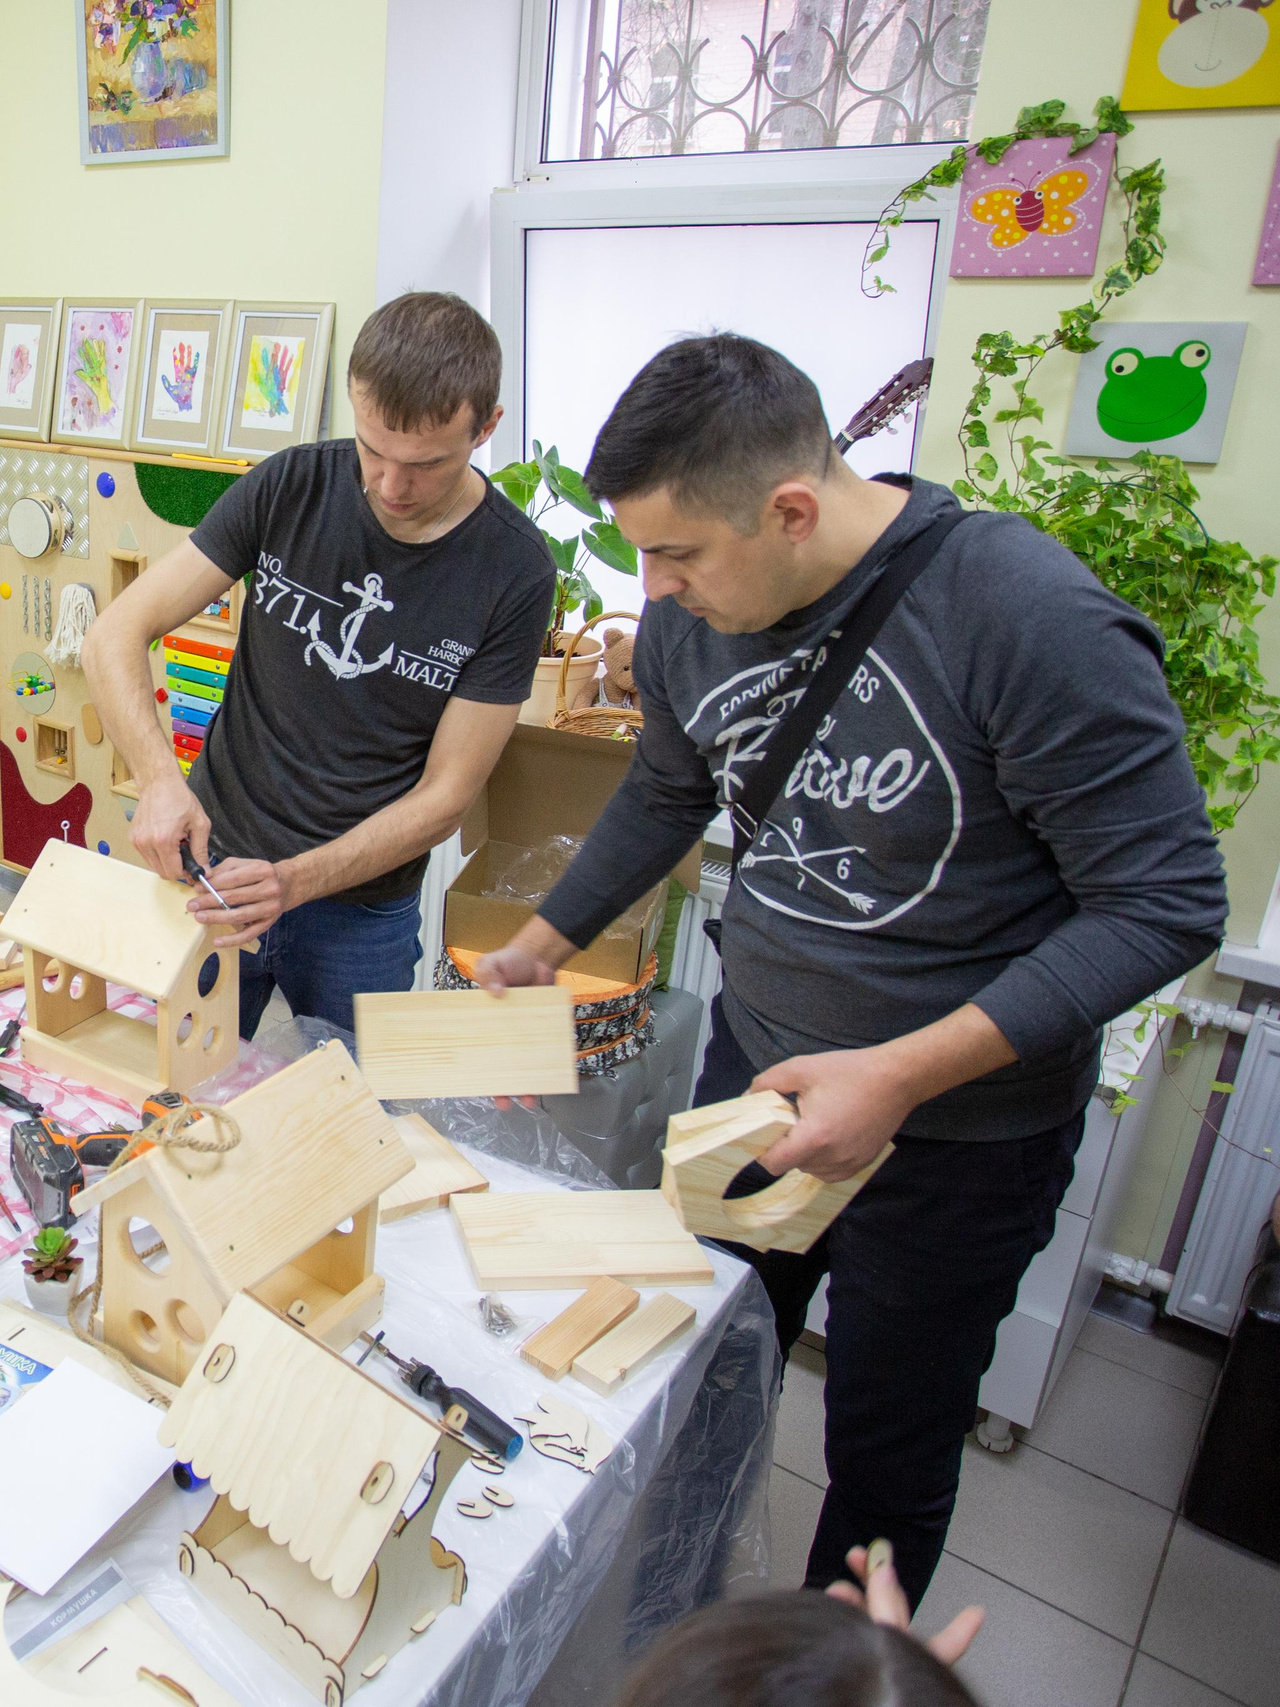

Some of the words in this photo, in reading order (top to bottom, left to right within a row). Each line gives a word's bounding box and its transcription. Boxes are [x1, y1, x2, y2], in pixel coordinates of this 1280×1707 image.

[258, 550, 282, 577] NO.
[391, 655, 459, 692] MALT
[836, 857, 851, 880] 6
[50, 1588, 98, 1628] КОРМУШКА
